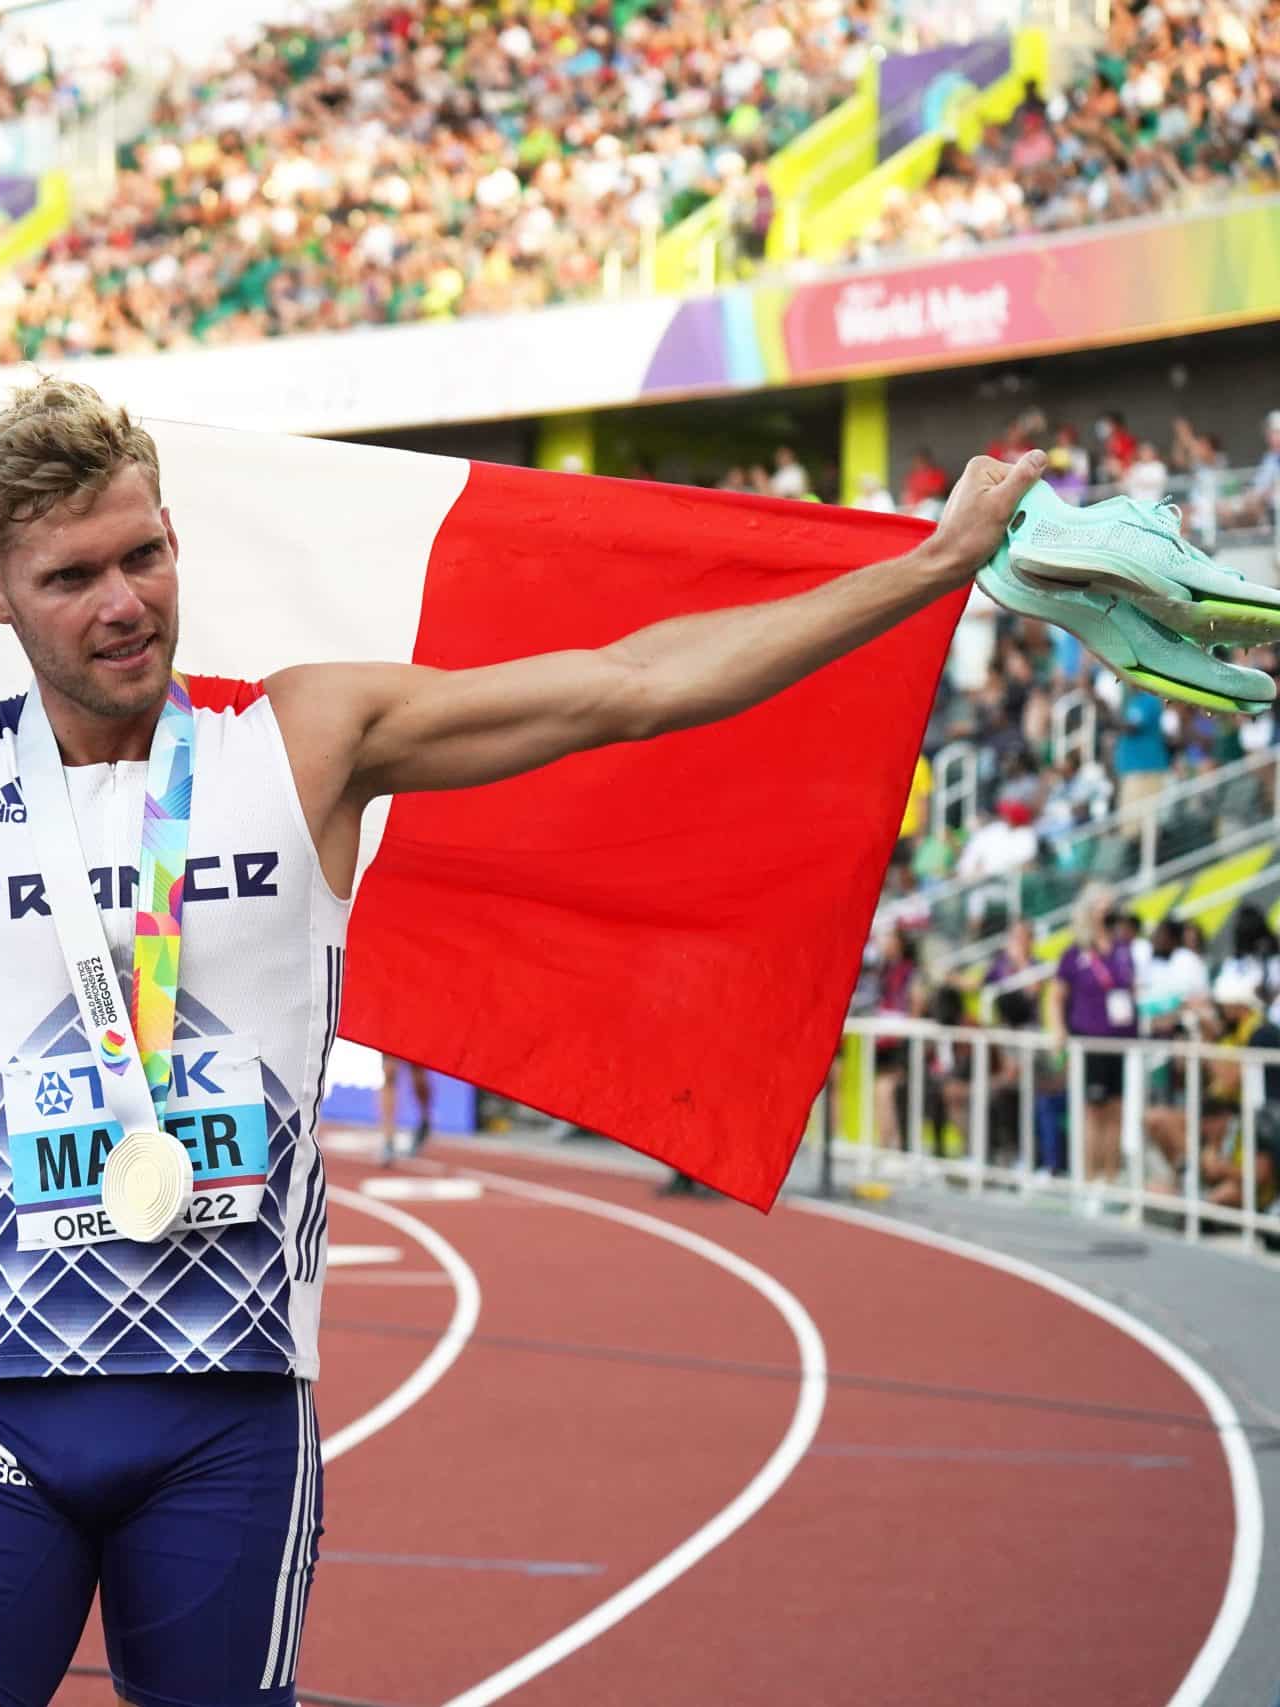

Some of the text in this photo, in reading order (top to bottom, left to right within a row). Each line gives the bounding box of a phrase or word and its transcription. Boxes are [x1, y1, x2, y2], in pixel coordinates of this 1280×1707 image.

[77, 960, 94, 999] ATHLETICS
[84, 960, 108, 1026] CHAMPIONSHIPS
[69, 1050, 225, 1109] TK
[36, 1113, 243, 1193] MAER
[54, 1193, 238, 1240] ORE22
